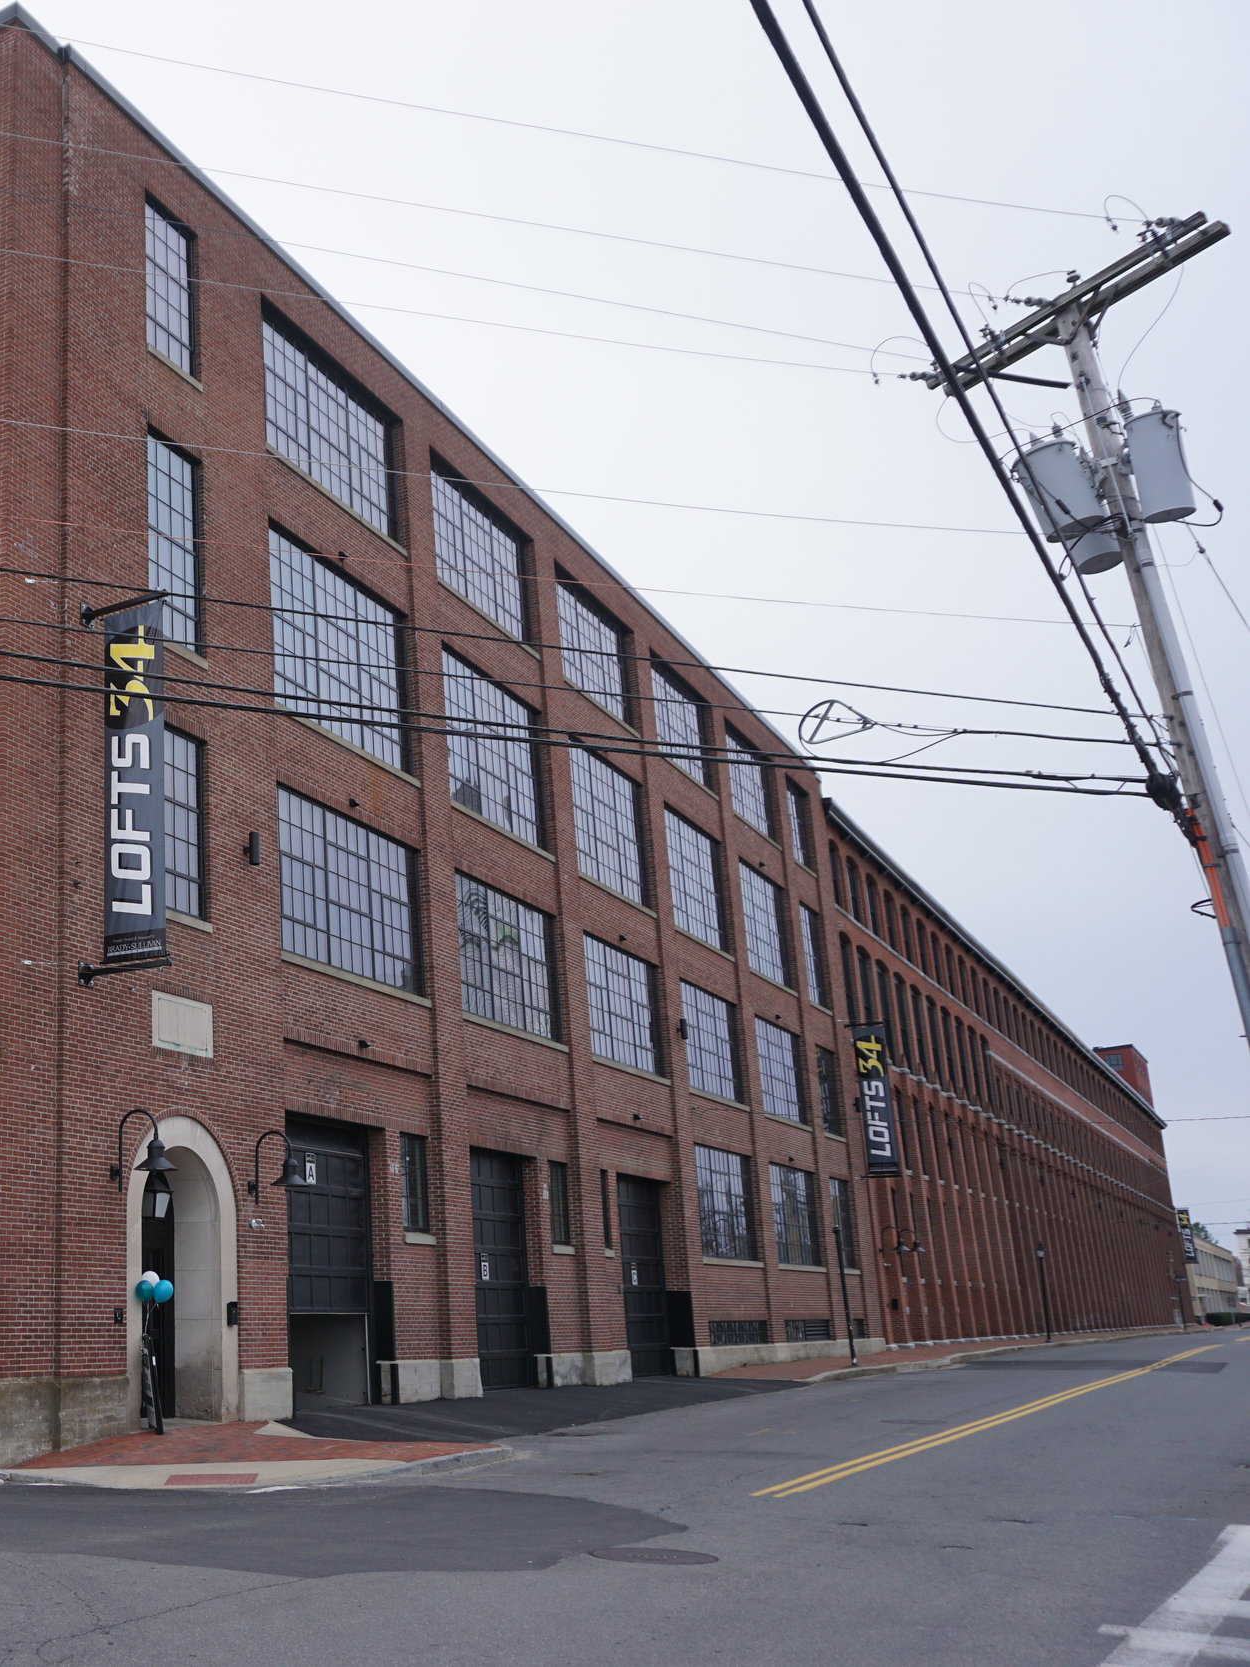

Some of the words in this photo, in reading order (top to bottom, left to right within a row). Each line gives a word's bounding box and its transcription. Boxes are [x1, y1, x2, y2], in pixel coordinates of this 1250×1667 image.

[110, 625, 155, 721] 34
[111, 733, 152, 915] LOFTS
[856, 1035, 885, 1077] 34
[863, 1080, 891, 1157] LOFTS
[307, 1165, 315, 1181] A
